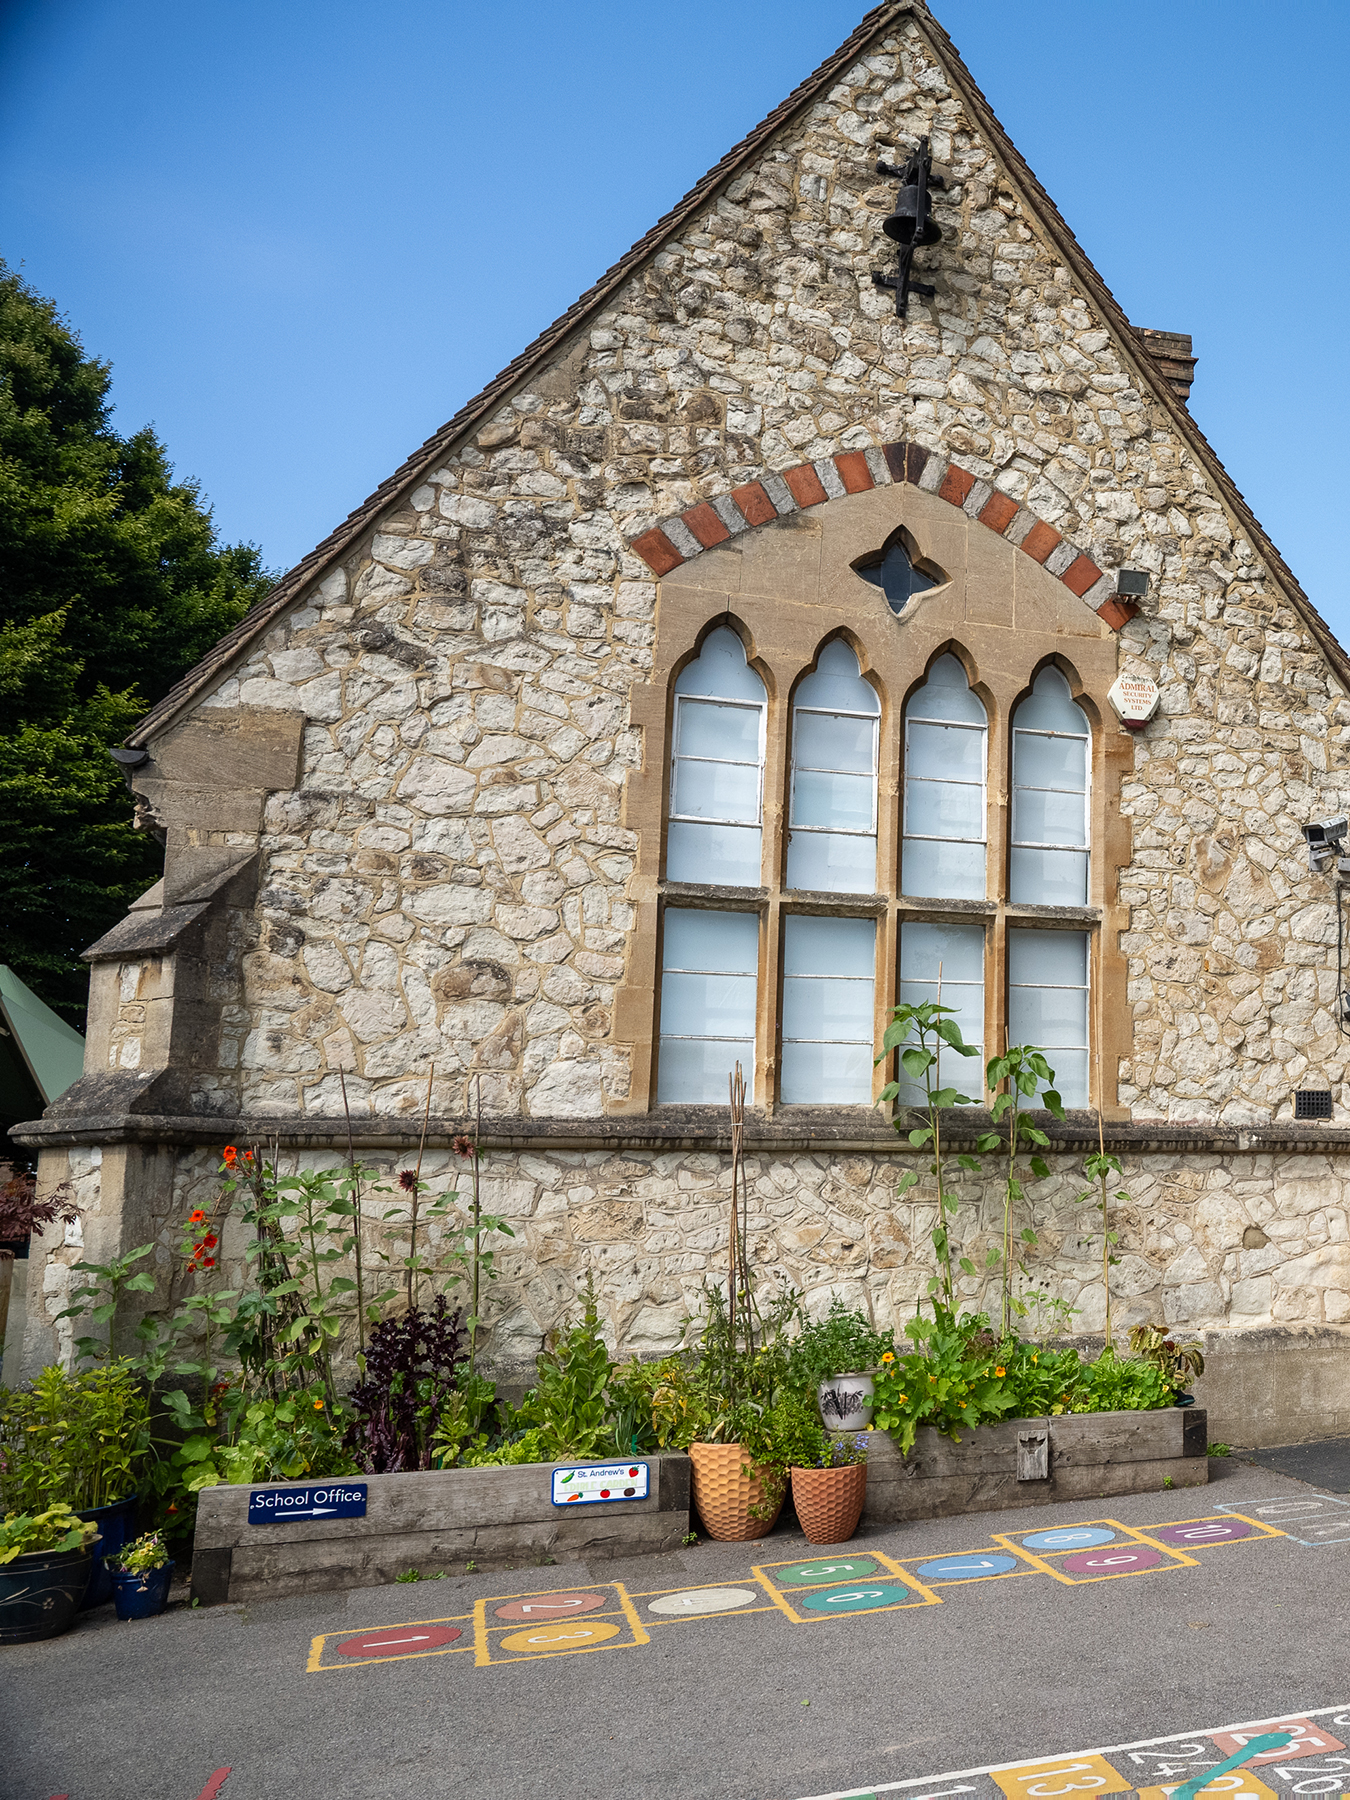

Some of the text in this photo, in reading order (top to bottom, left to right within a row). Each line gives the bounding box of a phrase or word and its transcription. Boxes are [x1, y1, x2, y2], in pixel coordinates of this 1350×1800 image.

[1119, 683, 1156, 692] ADMIRAL
[589, 1468, 624, 1477] Andrew's
[255, 1488, 362, 1508] School Office
[1043, 1532, 1093, 1544] 8
[1175, 1523, 1233, 1540] 10
[937, 1560, 995, 1572] 7
[1085, 1554, 1139, 1568] 9
[799, 1564, 855, 1577] 5
[825, 1590, 884, 1603] 6
[521, 1599, 583, 1613] 2
[362, 1635, 430, 1648] 1
[527, 1630, 594, 1644] 3
[1127, 1744, 1221, 1777] 24
[1016, 1763, 1107, 1797] 13
